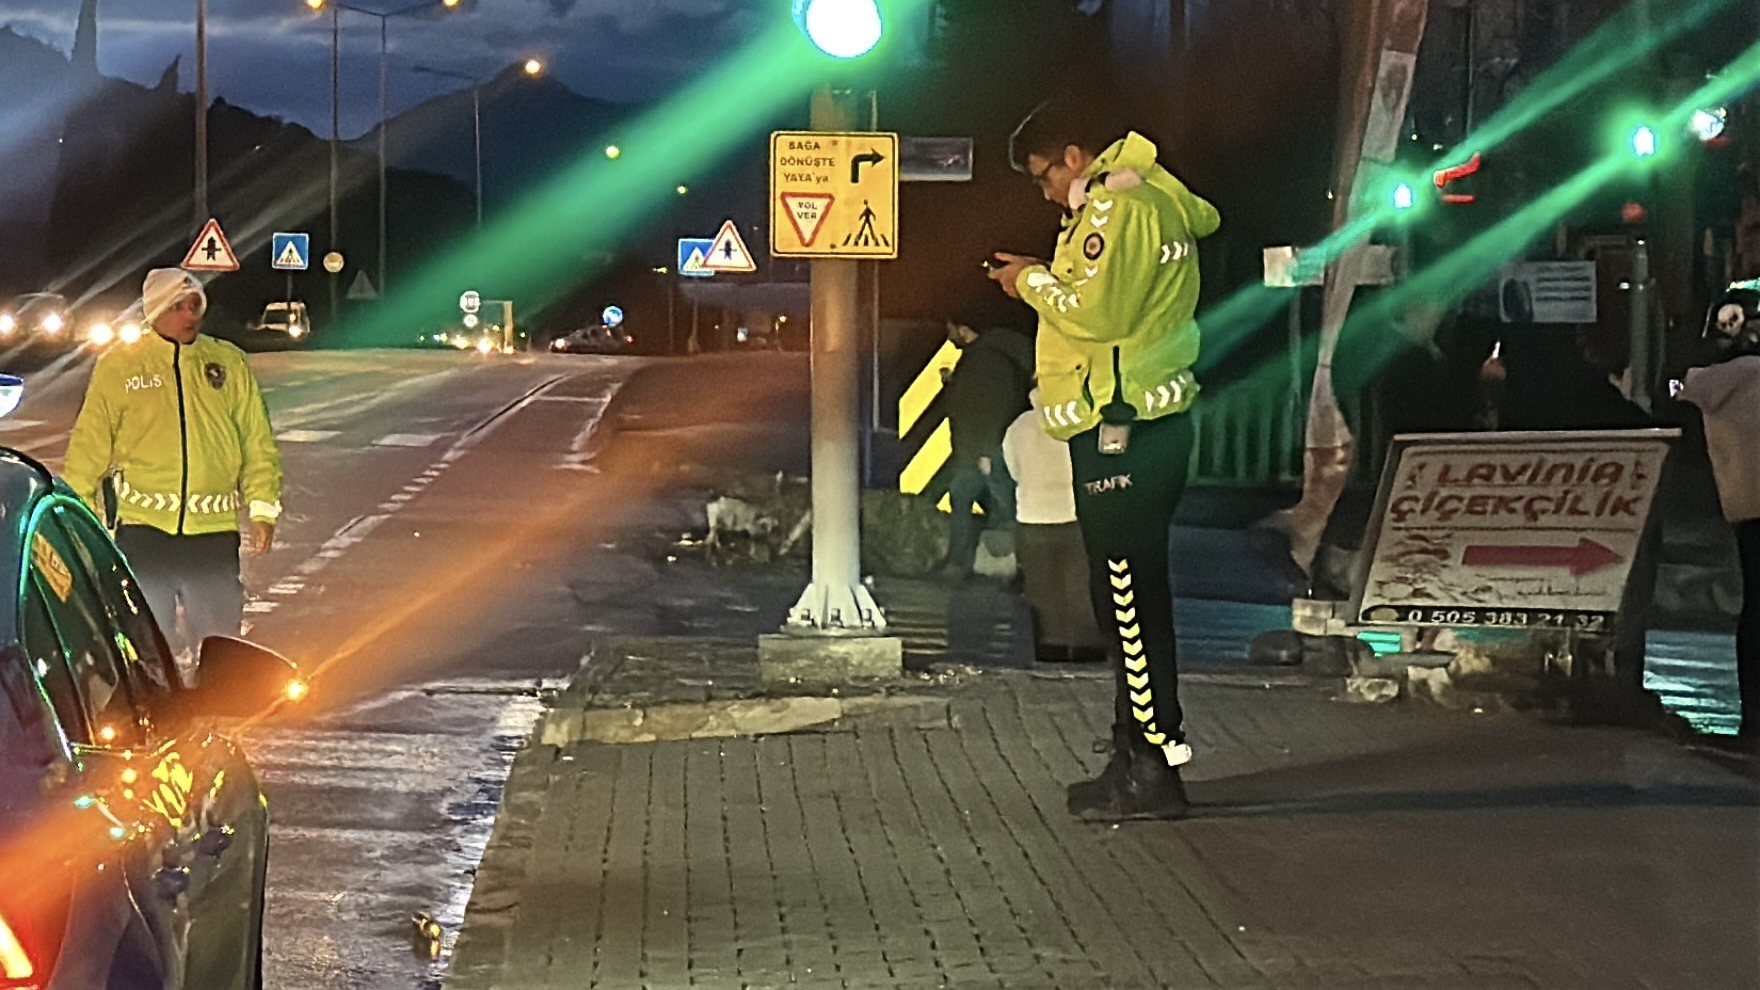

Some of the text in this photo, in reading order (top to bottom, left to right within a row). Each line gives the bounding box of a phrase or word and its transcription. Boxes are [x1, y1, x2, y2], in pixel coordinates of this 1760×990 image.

[797, 201, 818, 210] YOL
[797, 211, 817, 220] VER
[1431, 611, 1476, 623] 505
